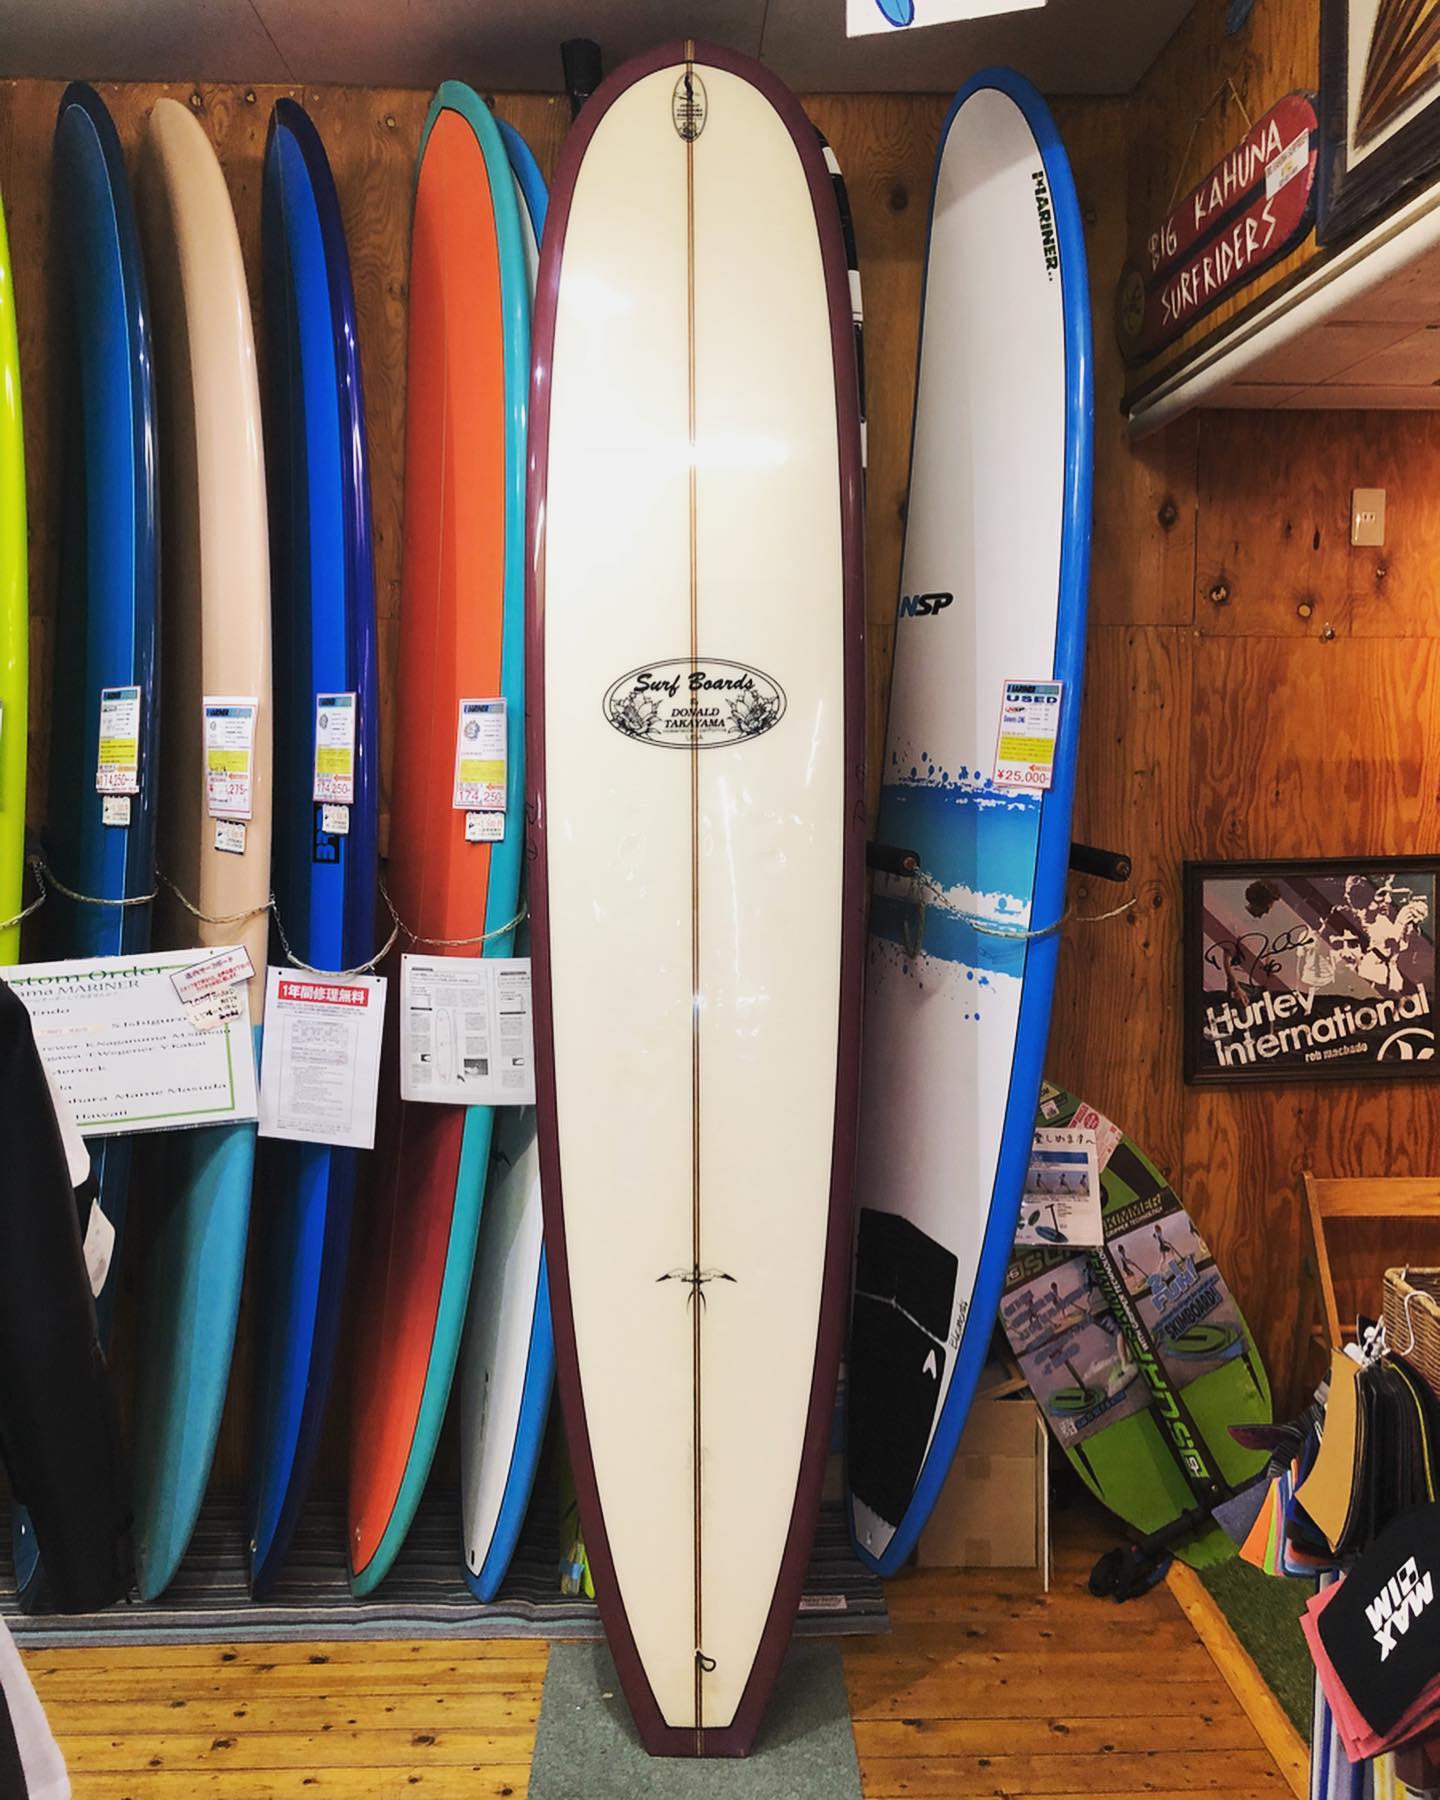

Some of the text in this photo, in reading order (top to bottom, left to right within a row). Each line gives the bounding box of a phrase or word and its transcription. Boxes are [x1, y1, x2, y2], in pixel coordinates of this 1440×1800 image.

[1149, 216, 1177, 272] BIG
[1194, 119, 1283, 231] KAHUNA
[1161, 198, 1277, 326] SURFRIDERS
[900, 592, 954, 618] NSP
[633, 671, 755, 697] Surf Boards
[1006, 694, 1057, 704] USED
[671, 707, 720, 717] DONALD
[664, 718, 726, 728] TAKAYAMA
[88, 965, 162, 982] Order
[57, 979, 140, 994] MARINER
[282, 983, 366, 1004] 1年間修理無料
[1205, 987, 1316, 1040] Hurley
[1214, 983, 1430, 1067] International
[1305, 1042, 1369, 1063] rob machado
[1135, 1330, 1149, 1351] WITH
[1373, 1571, 1434, 1662] MAX
